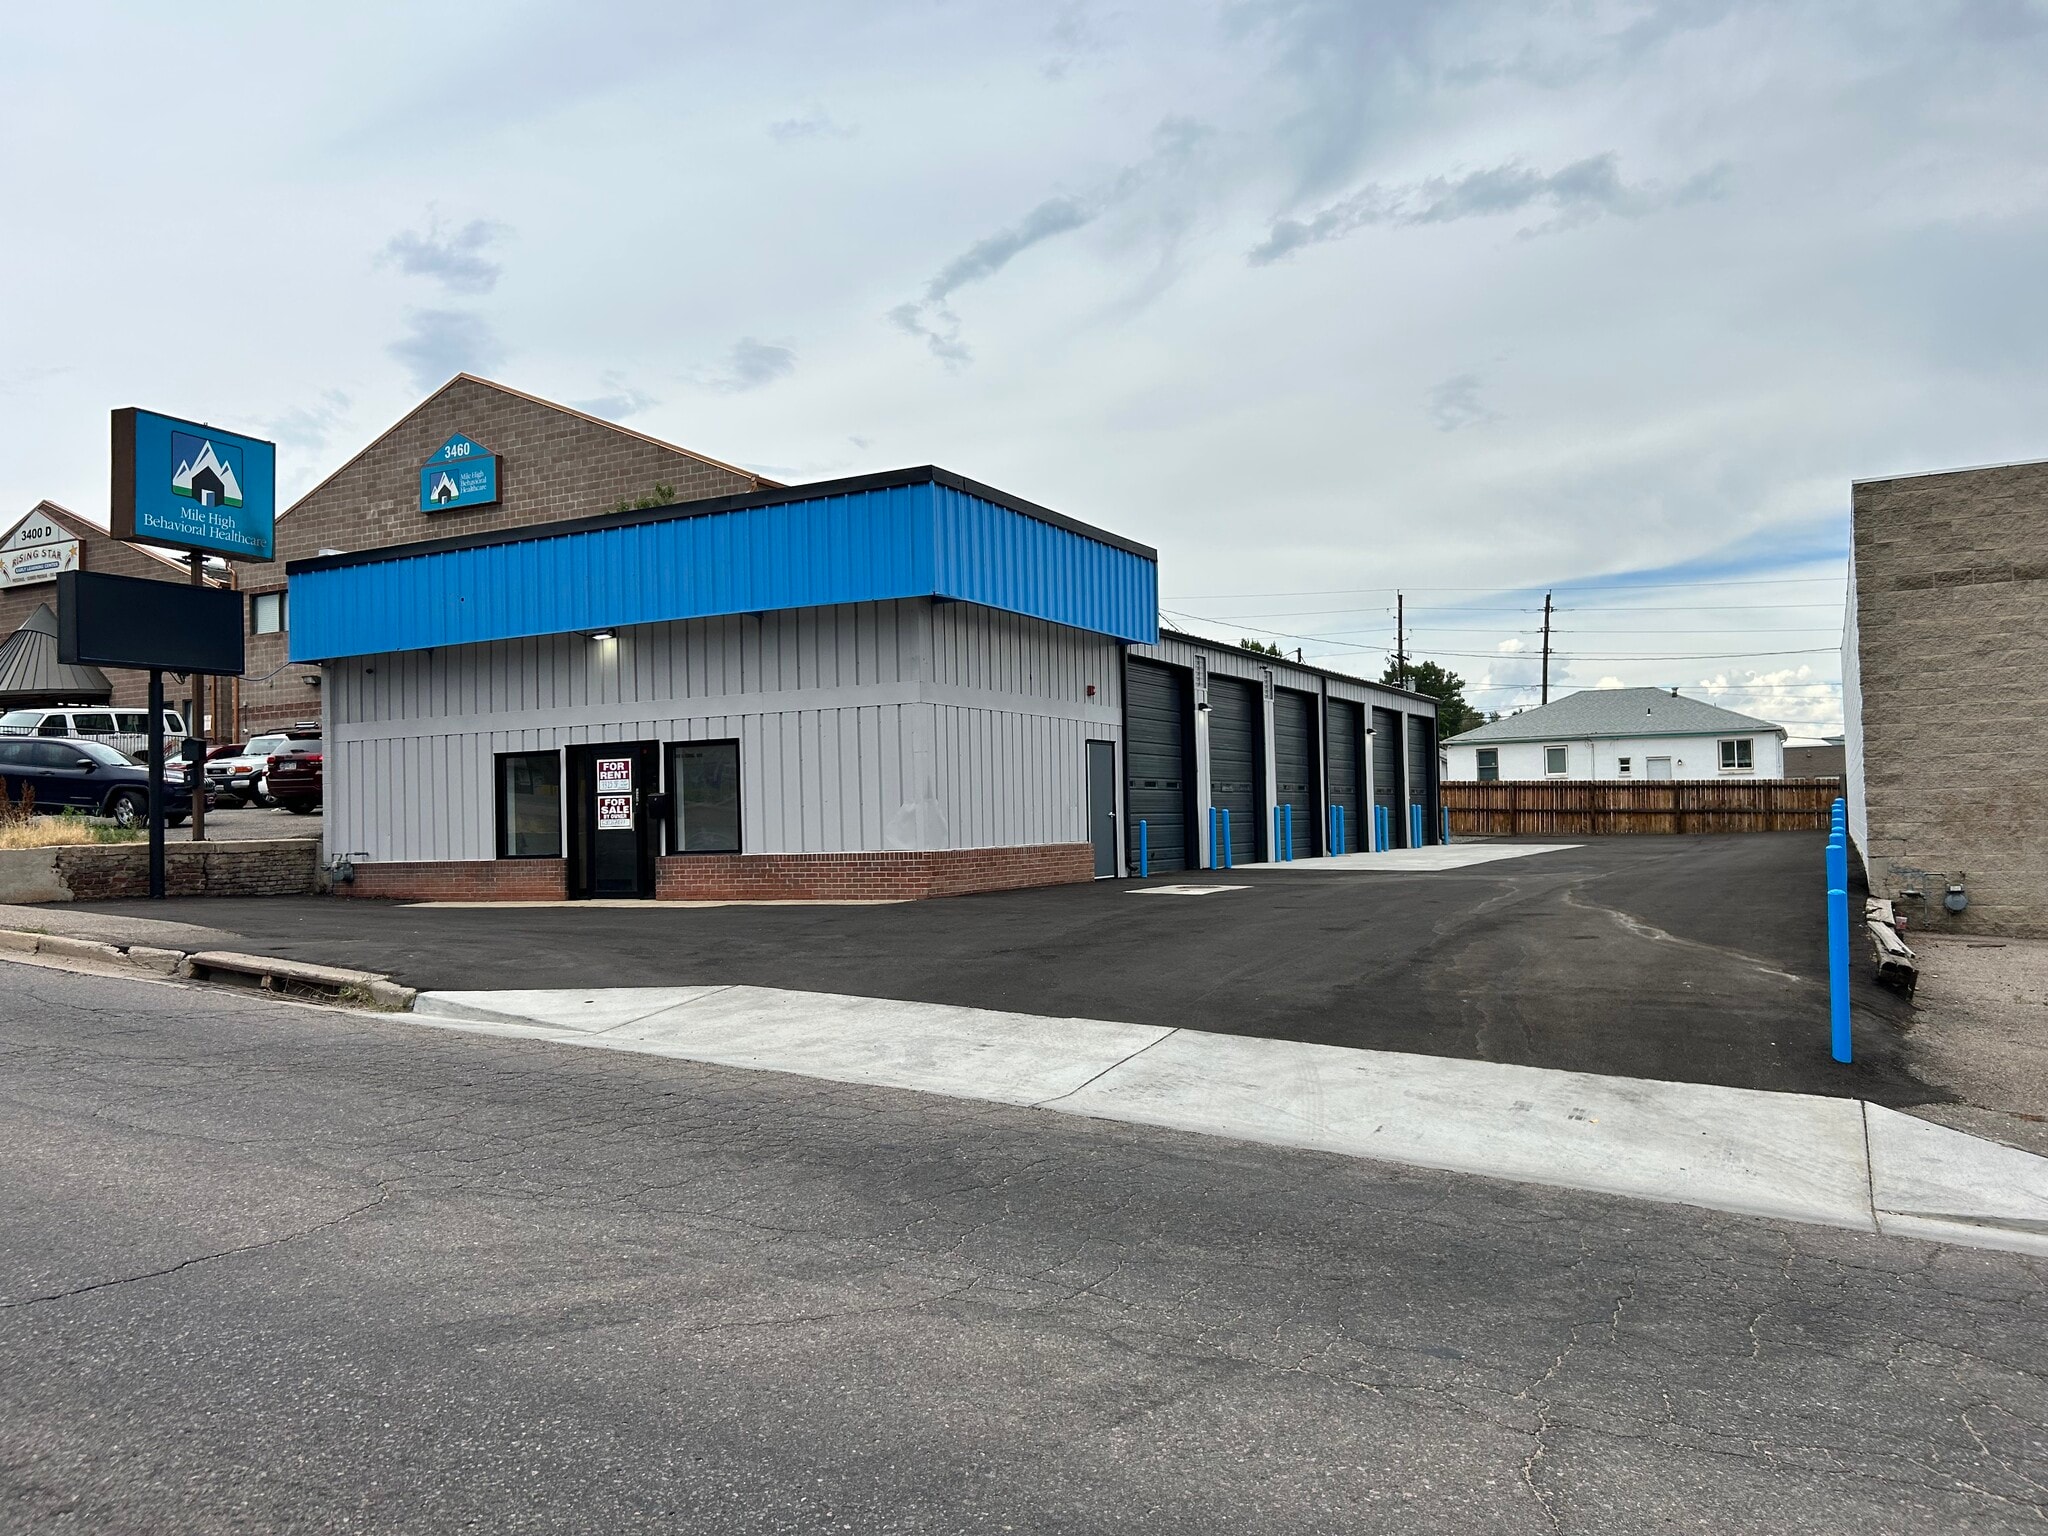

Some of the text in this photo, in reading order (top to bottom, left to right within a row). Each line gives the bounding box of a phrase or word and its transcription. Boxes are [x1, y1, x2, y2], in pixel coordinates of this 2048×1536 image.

[444, 442, 470, 458] 3460
[460, 470, 484, 480] Mile High
[460, 476, 486, 487] Behavioral
[460, 484, 487, 493] Healthcare
[180, 507, 236, 530] Mile High
[21, 526, 52, 541] 3400 D
[143, 513, 267, 548] Behavioral Healthcare
[12, 549, 62, 567] RISING STAR
[603, 762, 625, 771] FOR
[600, 770, 628, 780] RENT
[604, 798, 626, 806] FOR
[601, 805, 630, 814] SALE
